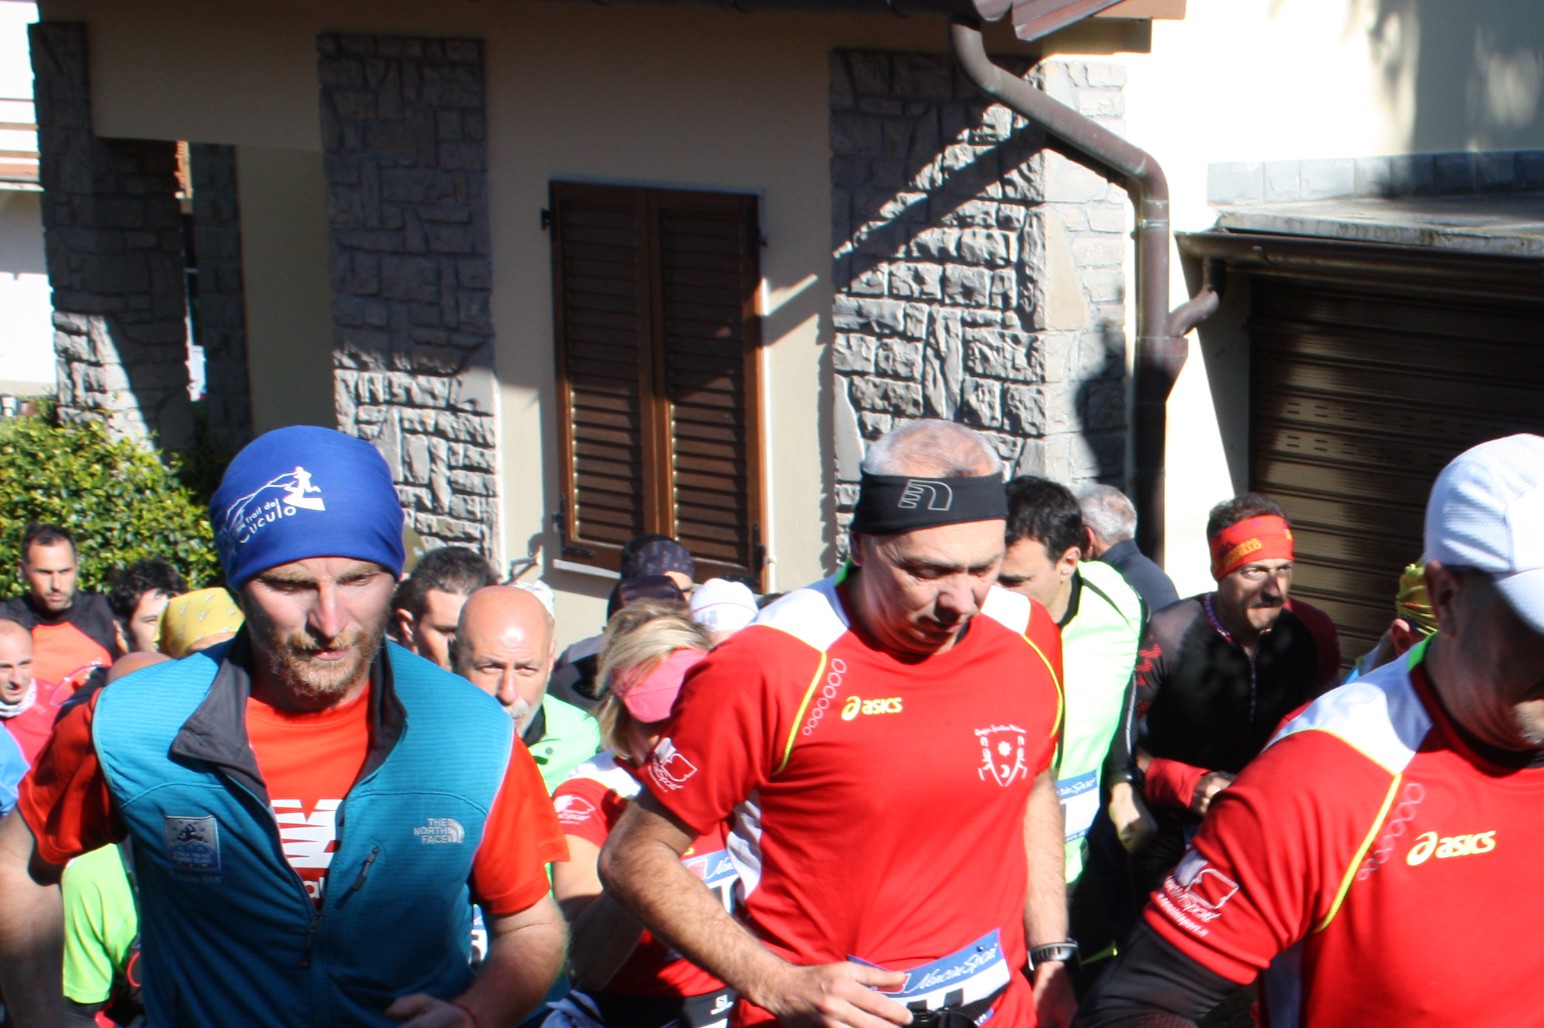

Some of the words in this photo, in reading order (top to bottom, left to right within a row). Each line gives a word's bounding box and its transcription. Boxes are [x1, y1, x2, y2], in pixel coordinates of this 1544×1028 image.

[427, 818, 448, 827] THE
[414, 827, 448, 836] NORTH
[421, 835, 448, 844] FACE
